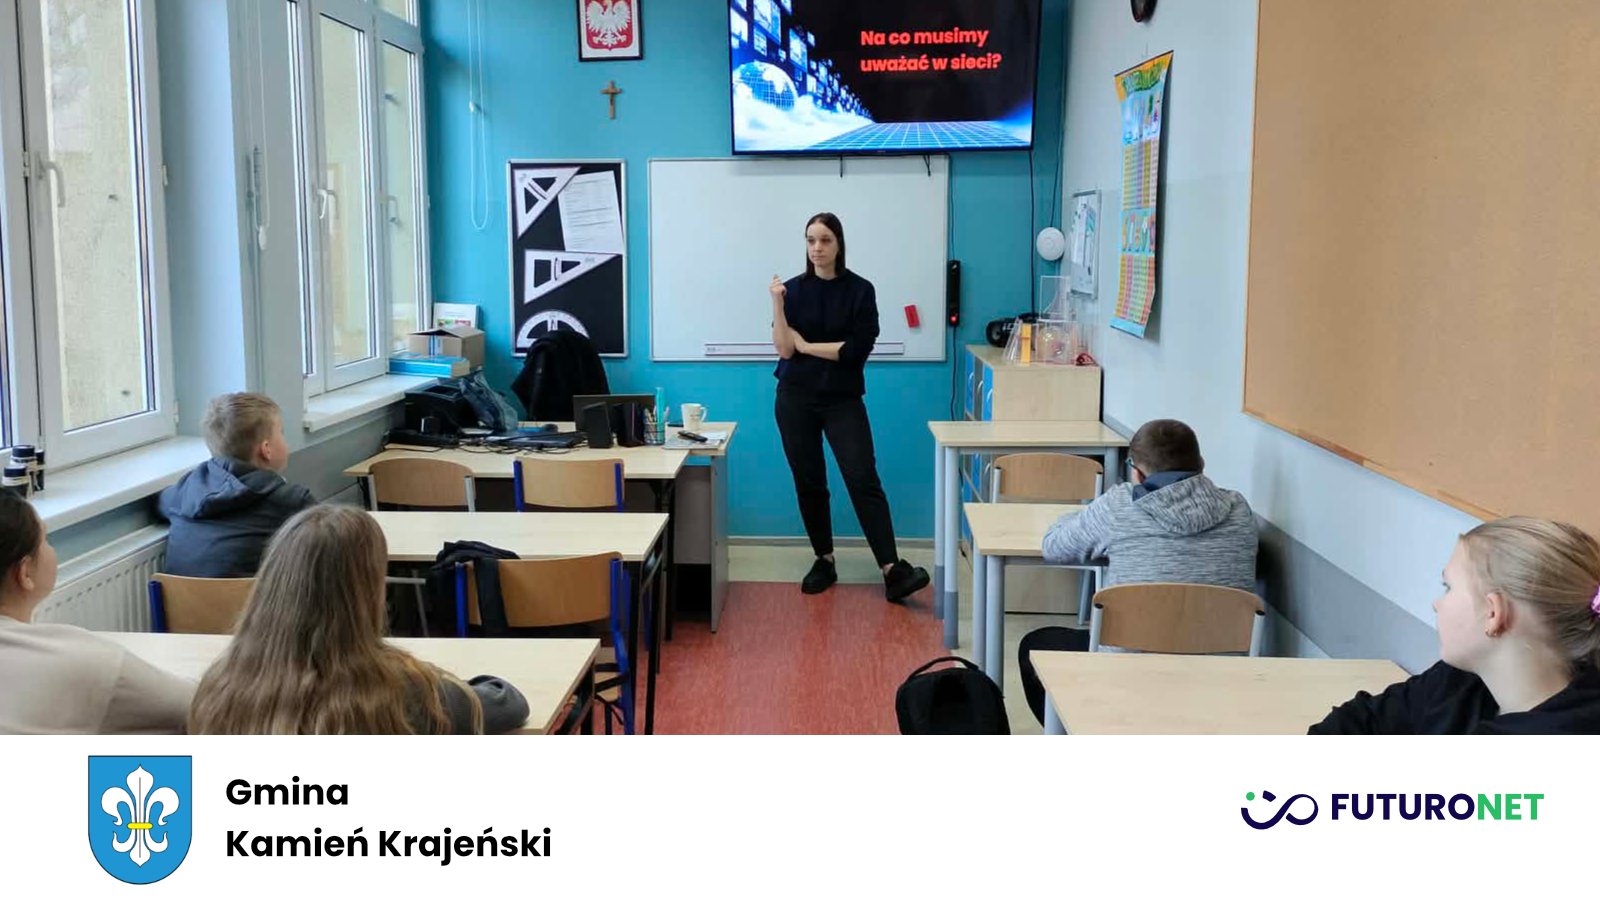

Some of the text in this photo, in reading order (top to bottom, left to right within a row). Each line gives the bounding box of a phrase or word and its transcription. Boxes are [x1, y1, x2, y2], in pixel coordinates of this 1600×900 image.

[861, 27, 989, 48] Na co musimy
[861, 53, 1002, 72] uważać w sieci?
